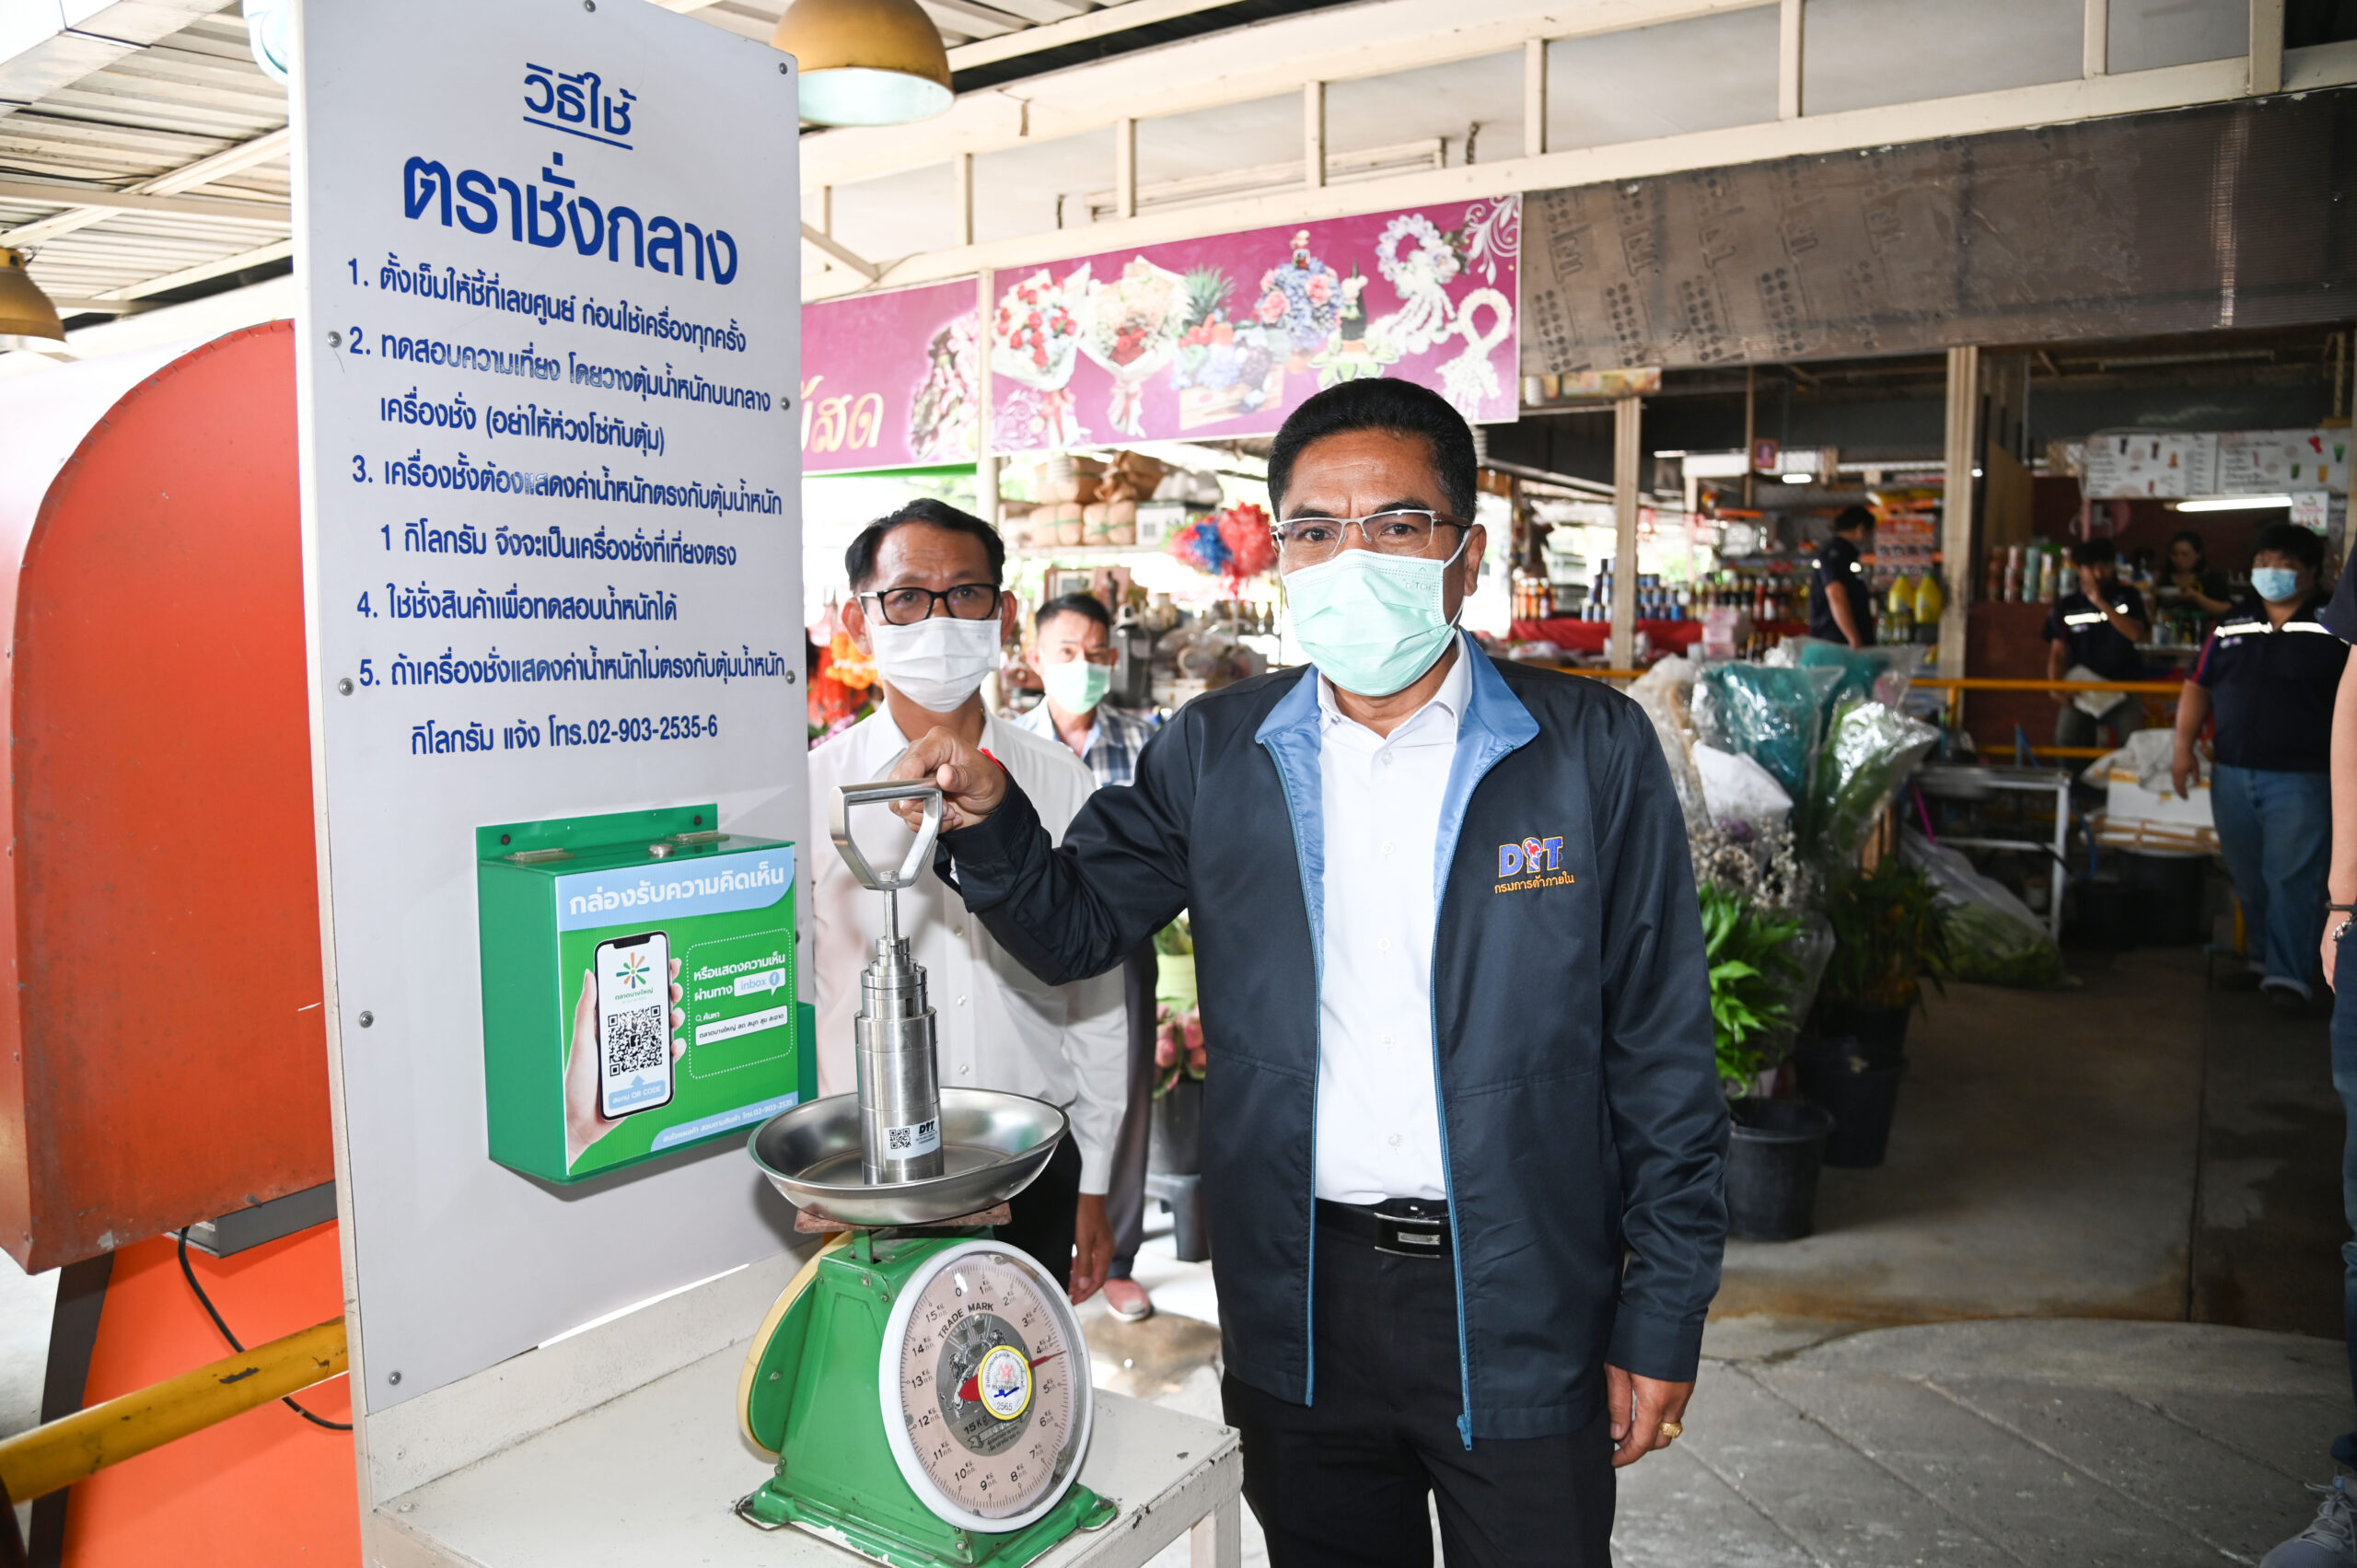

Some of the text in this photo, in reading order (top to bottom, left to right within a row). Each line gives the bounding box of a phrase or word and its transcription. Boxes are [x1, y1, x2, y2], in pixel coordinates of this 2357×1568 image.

[523, 63, 637, 136] วิธีใช้
[403, 152, 737, 285] ตราชั่งกลาง
[348, 252, 747, 353] 1. ตั้งเข็มให้ชี้ที่เลขศูนย์ ก่อนใช้เครื่องทุกครั้ง
[350, 326, 771, 412] 2. ทดสอบความเที่ยง โดยวางตุ้มน้ำหนักบนกลาง
[380, 386, 665, 457] เครื่องชั่ง (อย่าให้ห่วงโซ่ทับตุ้ม)
[352, 455, 373, 483] 3.
[380, 517, 737, 566] 1 กิโลกรัม จึงจะเป็นเครื่องชั่งที่เที่ยงตรง
[356, 580, 678, 621] 4. ใช้ชั่งสินค้าเพื่อทดสอบน้ำหนักได้
[359, 645, 785, 687] 5. ถ้าเครื่องชั่งแสดงค่าน้ำหนักไม่ตรงกับตุ้มน้ำหนัก
[412, 714, 718, 755] กิโลกรัม แจ้ง โทร.02-903-2535-6
[569, 861, 784, 915] กล่องรับความคิดเห็น
[1493, 871, 1575, 894] กรมการค้าภายใน
[693, 950, 786, 981] หรือแสดงความเห็น
[694, 979, 767, 1002] ผ่านทาง inbox
[955, 1287, 962, 1297] 0
[979, 1285, 984, 1295] 1
[1003, 1296, 1009, 1307] 2
[925, 1310, 937, 1323] 15
[938, 1302, 994, 1339] TRADE MARK
[1022, 1317, 1028, 1328] 3
[912, 1344, 924, 1356] 14
[1036, 1345, 1042, 1354] 4
[911, 1376, 923, 1388] 13
[1042, 1383, 1050, 1394] 5
[996, 1401, 1013, 1411] 2565
[918, 1415, 930, 1428] 12
[1039, 1417, 1047, 1427] 6
[934, 1449, 944, 1460] 11
[1029, 1449, 1036, 1459] 7
[955, 1468, 967, 1481] 10
[1010, 1471, 1018, 1482] 8
[980, 1481, 988, 1491] 9
